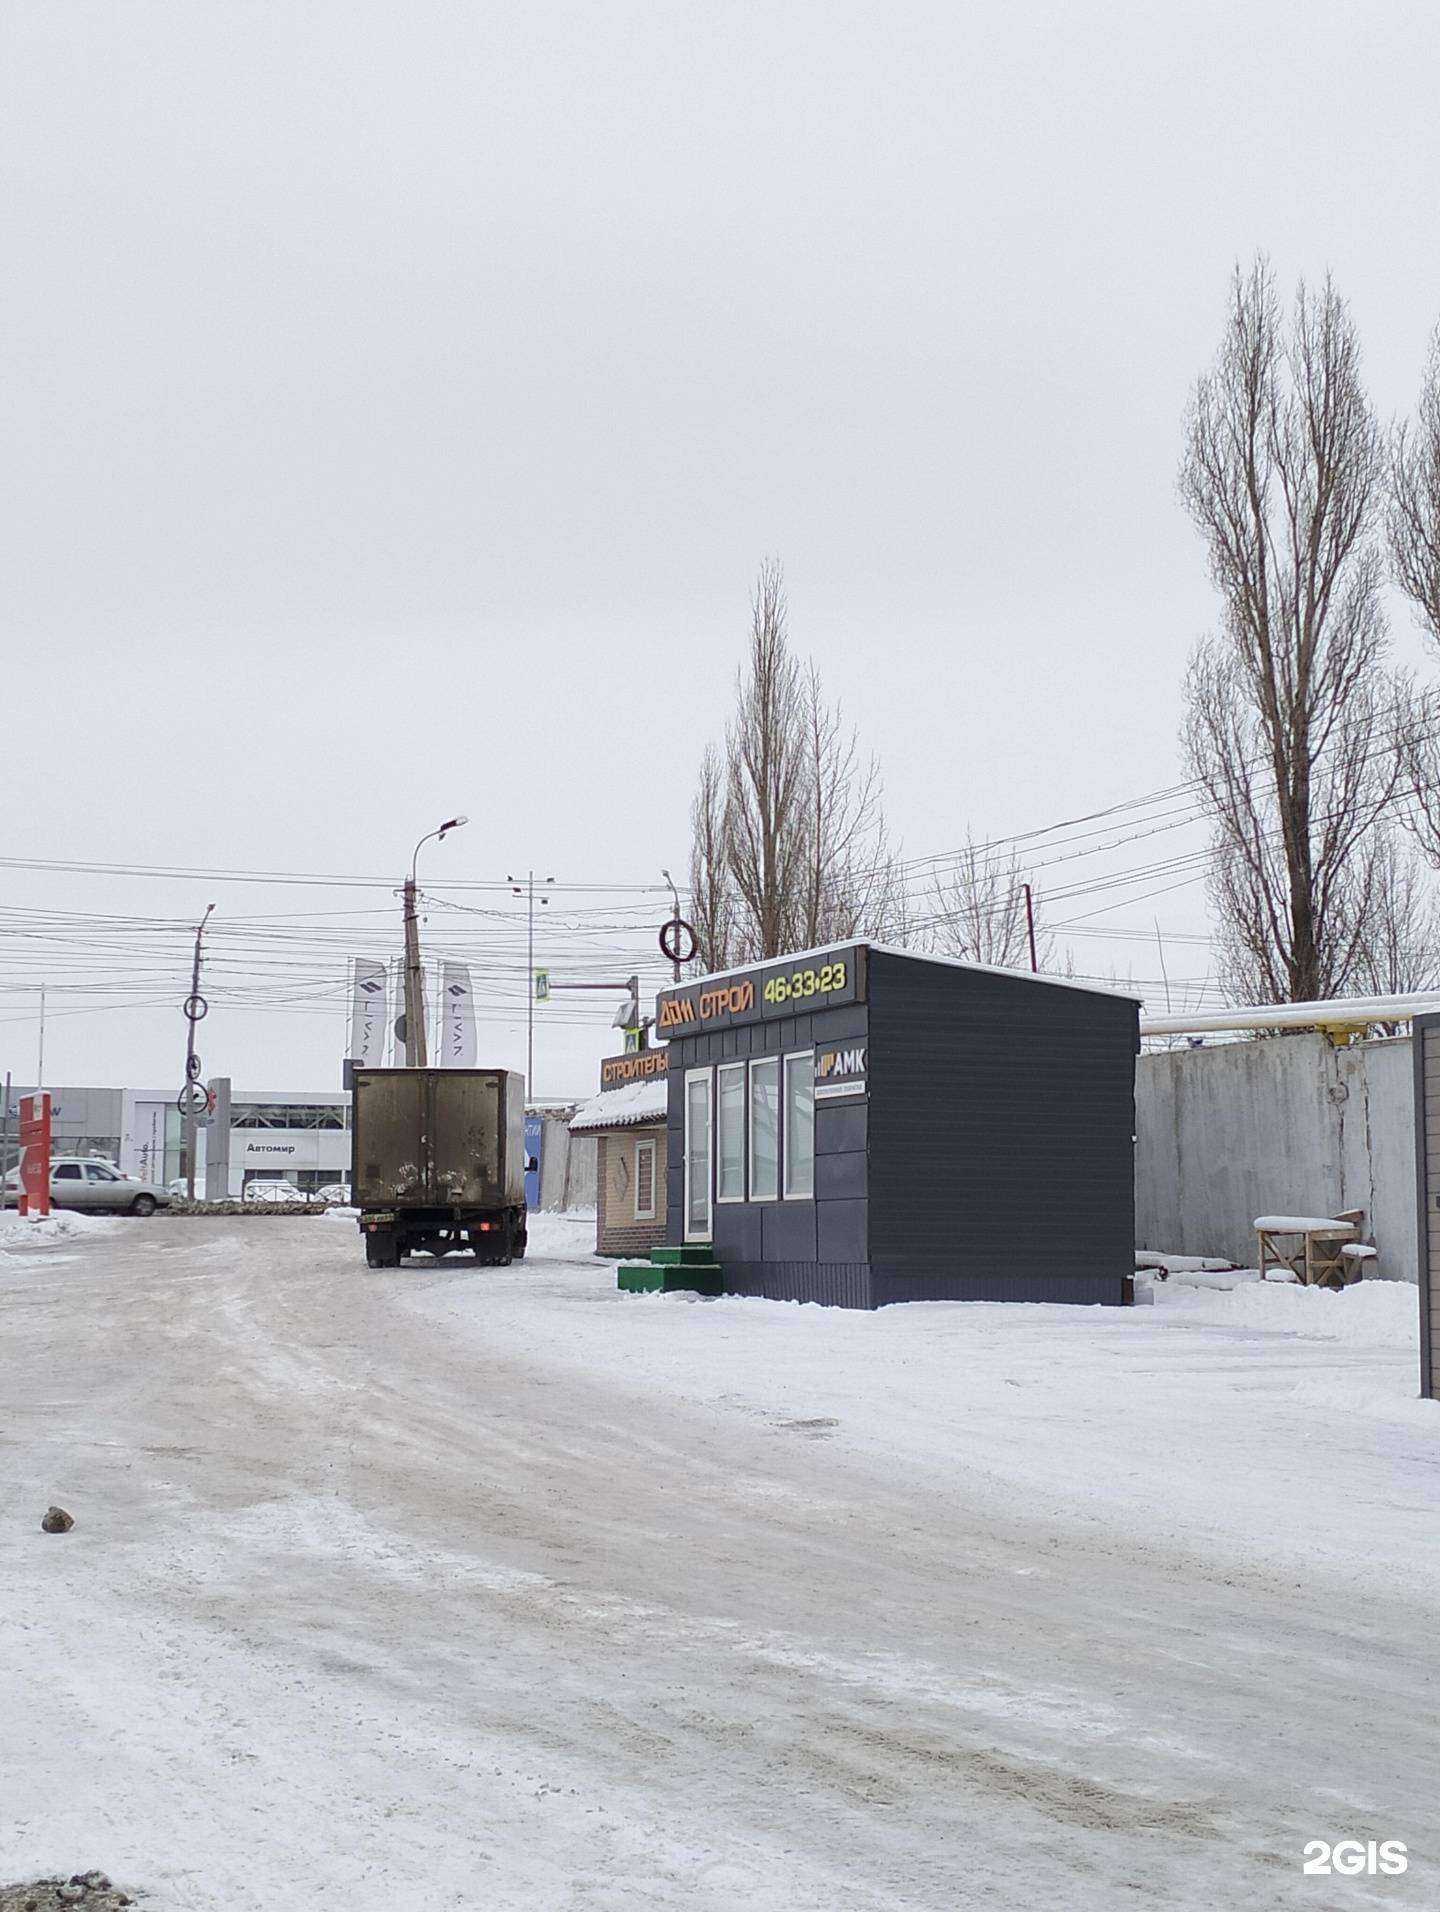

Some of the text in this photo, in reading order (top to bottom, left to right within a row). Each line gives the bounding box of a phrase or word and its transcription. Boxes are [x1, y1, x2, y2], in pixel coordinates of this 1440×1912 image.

[659, 998, 696, 1028] ДОМ
[700, 980, 755, 1019] СТРОЙ
[247, 1143, 295, 1154] Автомир
